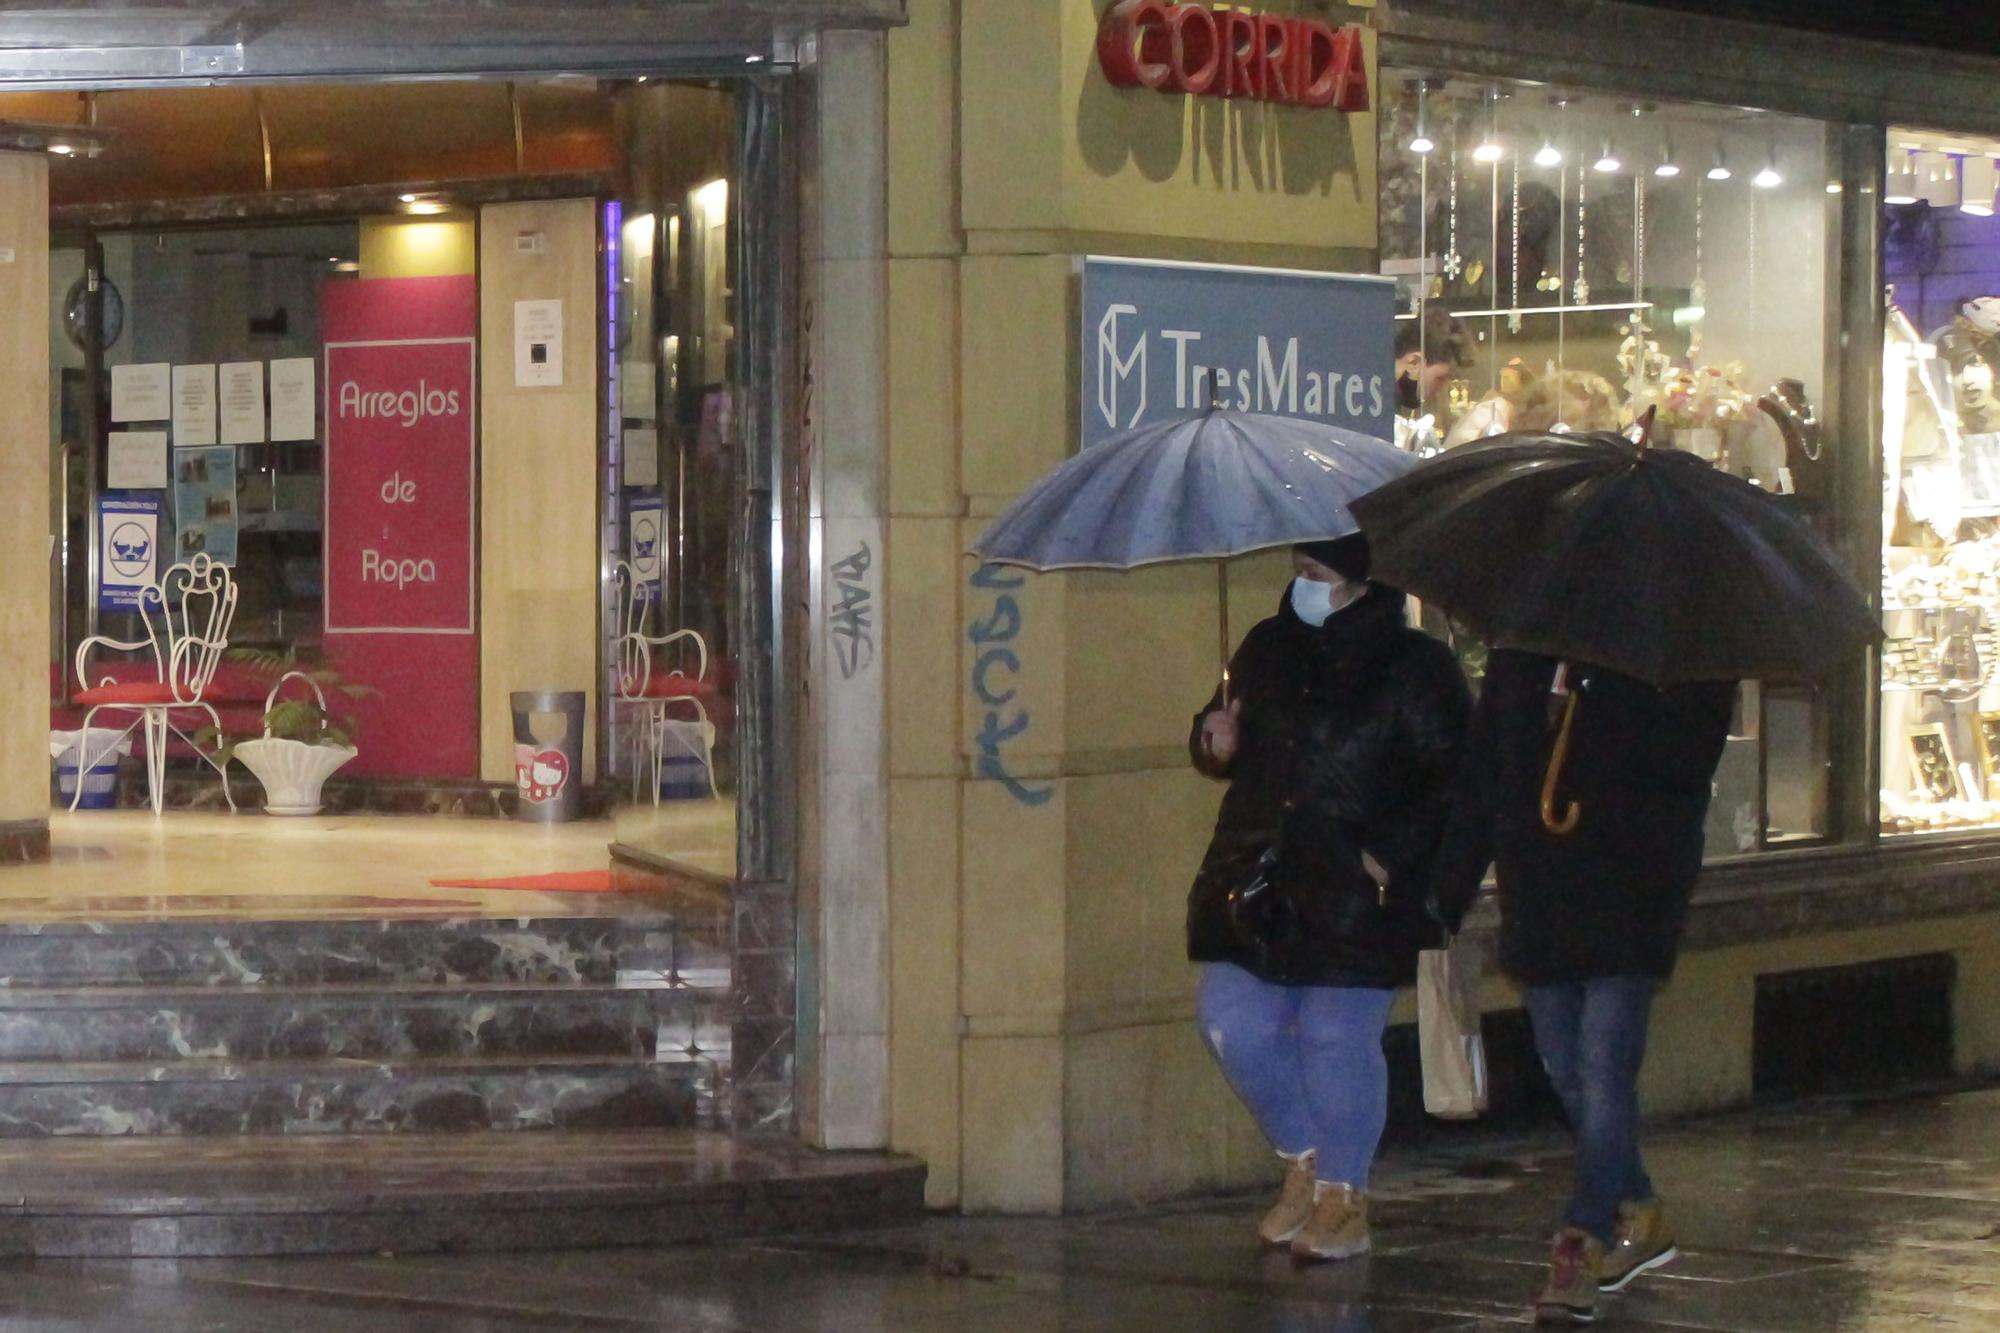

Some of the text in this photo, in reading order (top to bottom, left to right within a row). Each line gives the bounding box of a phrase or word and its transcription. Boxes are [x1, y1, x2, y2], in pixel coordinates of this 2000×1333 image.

[1098, 0, 1370, 112] CORRIDA
[339, 378, 460, 428] Arreglos
[380, 471, 417, 504] de
[361, 549, 436, 591] Ropa
